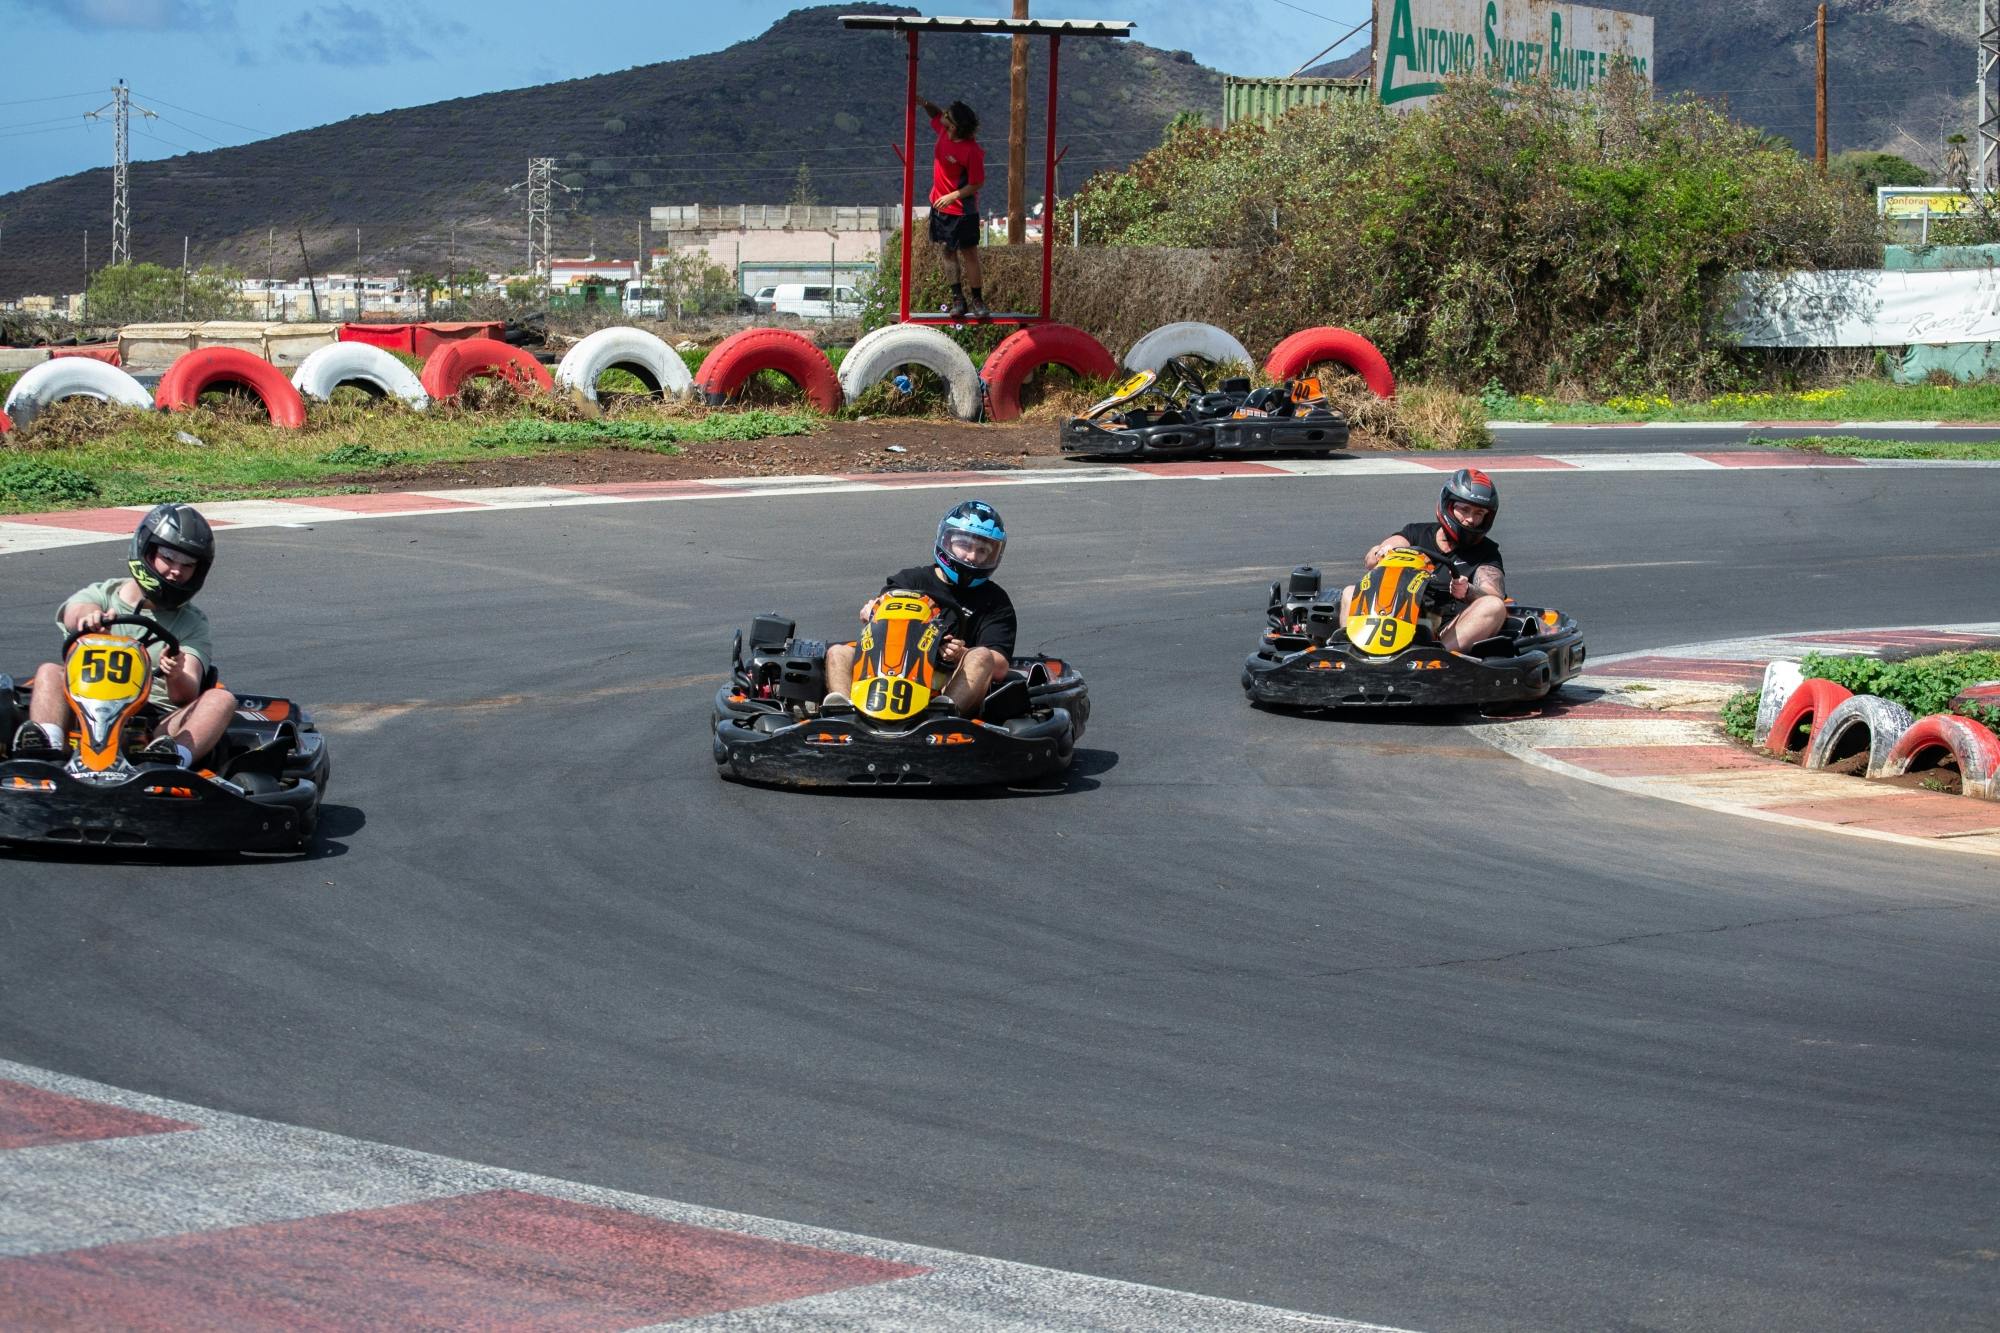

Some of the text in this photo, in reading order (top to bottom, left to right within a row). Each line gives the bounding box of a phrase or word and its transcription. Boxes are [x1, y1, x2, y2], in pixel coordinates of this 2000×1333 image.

[1551, 12, 1595, 92] BAUTE
[1887, 196, 1937, 205] Conforama
[885, 602, 924, 612] 69
[1364, 618, 1398, 647] 79
[82, 650, 132, 684] 59
[866, 678, 913, 715] 69
